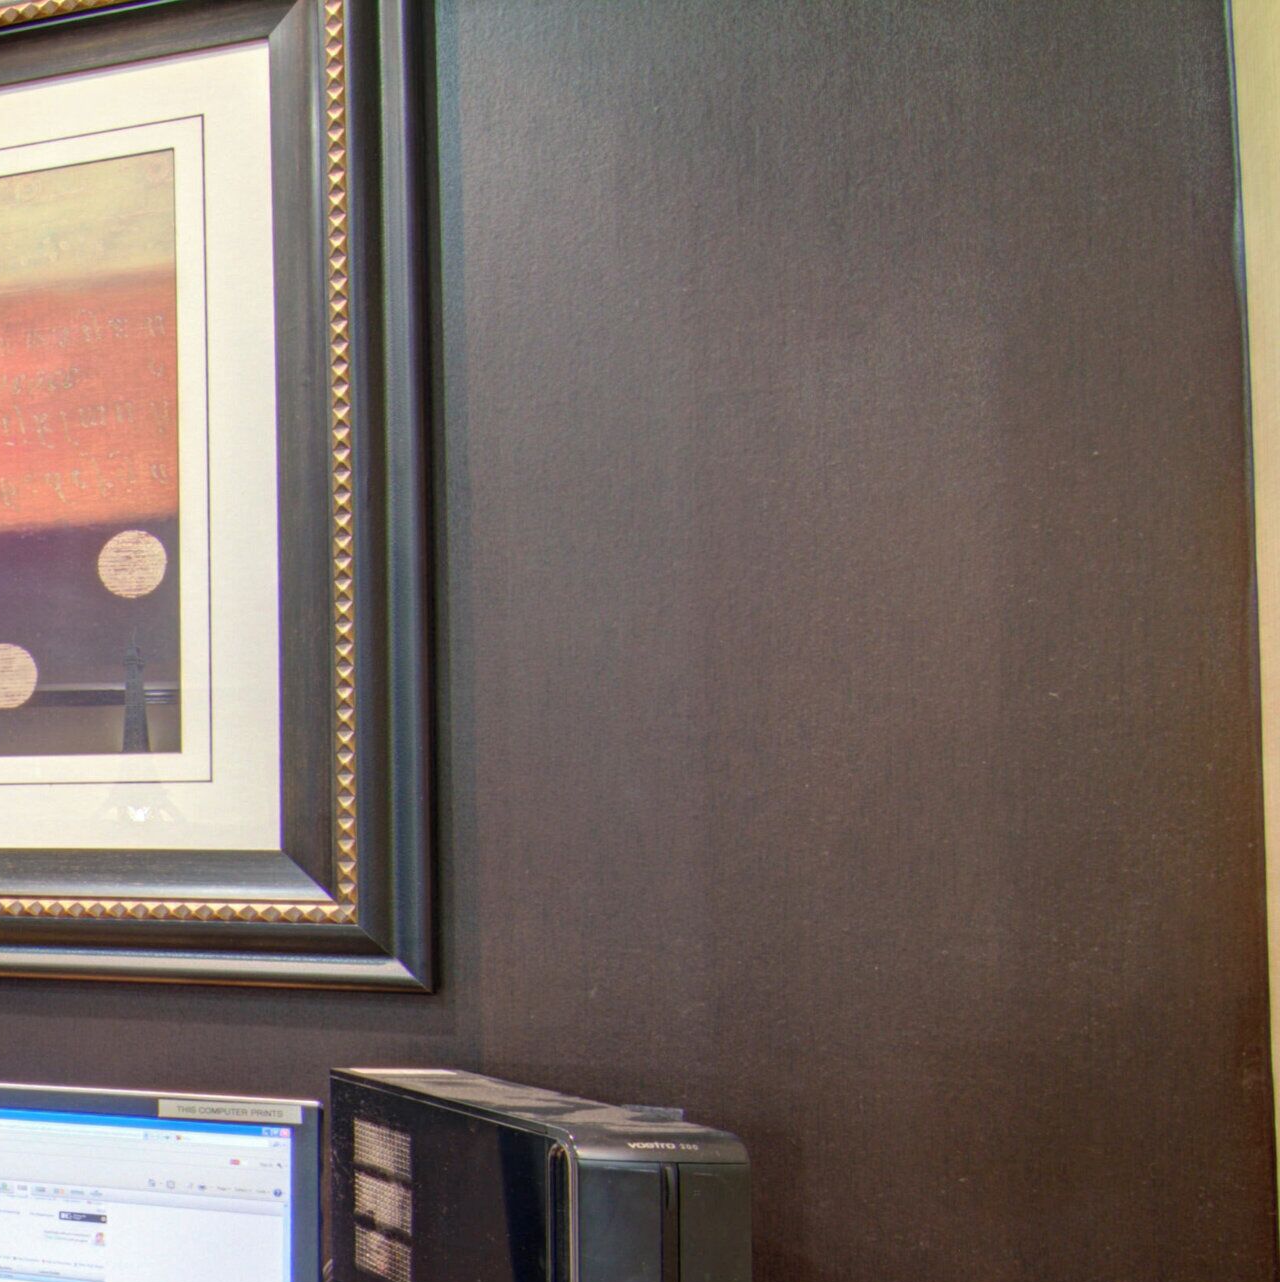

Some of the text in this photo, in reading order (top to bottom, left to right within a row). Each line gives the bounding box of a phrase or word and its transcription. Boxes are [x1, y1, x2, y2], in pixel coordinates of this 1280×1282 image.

[176, 1105, 284, 1118] THIS COMPUTER PRINTS
[626, 1141, 676, 1149] vostro
